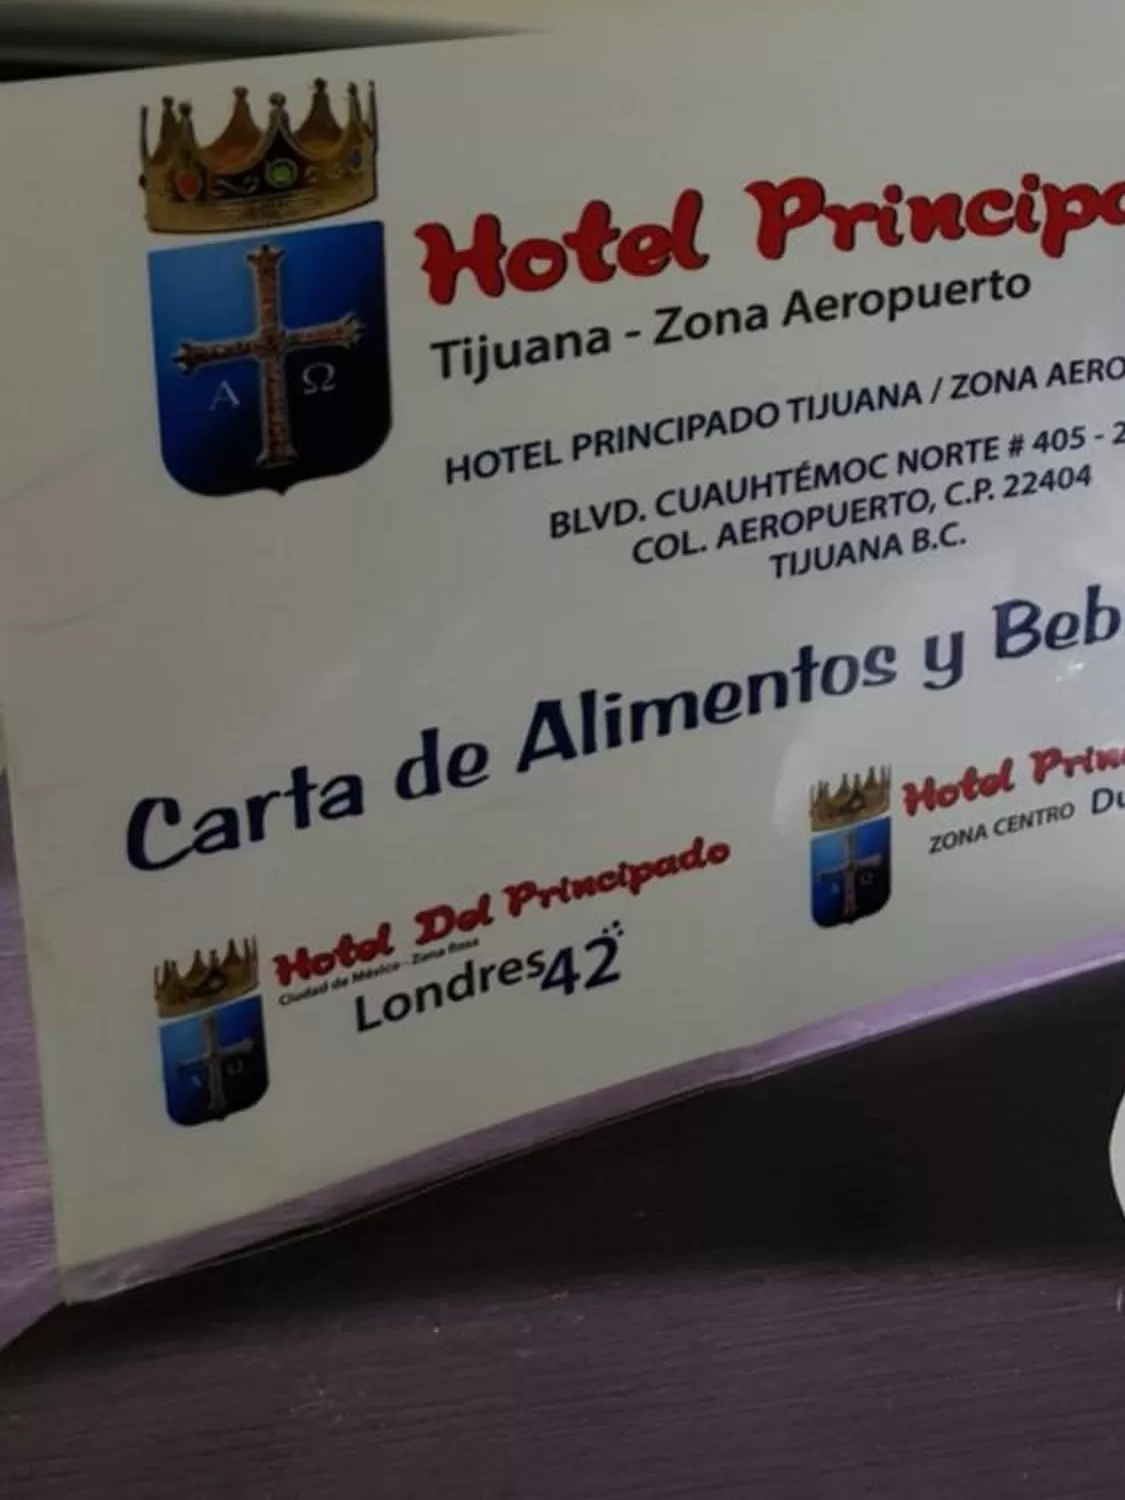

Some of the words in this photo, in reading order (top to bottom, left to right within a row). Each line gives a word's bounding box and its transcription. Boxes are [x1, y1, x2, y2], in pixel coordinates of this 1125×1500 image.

[413, 188, 710, 307] Hotel
[431, 324, 611, 384] Tijuana
[653, 300, 768, 346] Zona
[782, 271, 1031, 325] Aeropuerto
[444, 433, 562, 485] HOTEL
[571, 399, 778, 461] PRINCIPADO
[787, 380, 921, 426] TIJUANA
[950, 365, 1037, 400] ZONA
[549, 496, 646, 540] BLVD.
[655, 453, 888, 518] CUAUHTÉMOC
[897, 435, 999, 477] NORTE
[1032, 426, 1085, 455] 405
[632, 528, 707, 566] COL.
[716, 489, 934, 550] AEROPUERTO,
[945, 481, 994, 507] C.P.
[1002, 465, 1091, 498] 22404
[769, 534, 902, 579] TIJUANA
[913, 523, 966, 551] B.C.
[127, 766, 365, 871] Carta
[395, 727, 489, 799] de
[516, 644, 897, 773] Alimentos
[924, 631, 963, 690] y
[902, 758, 1014, 816] Hotel
[929, 825, 987, 854] ZONA
[993, 802, 1075, 837] CENTRO
[273, 922, 395, 987] Hotel
[414, 894, 494, 945] Del
[502, 836, 731, 917] Principado
[278, 980, 328, 1006] Ciudad
[331, 976, 348, 990] de
[412, 949, 446, 965] Zona
